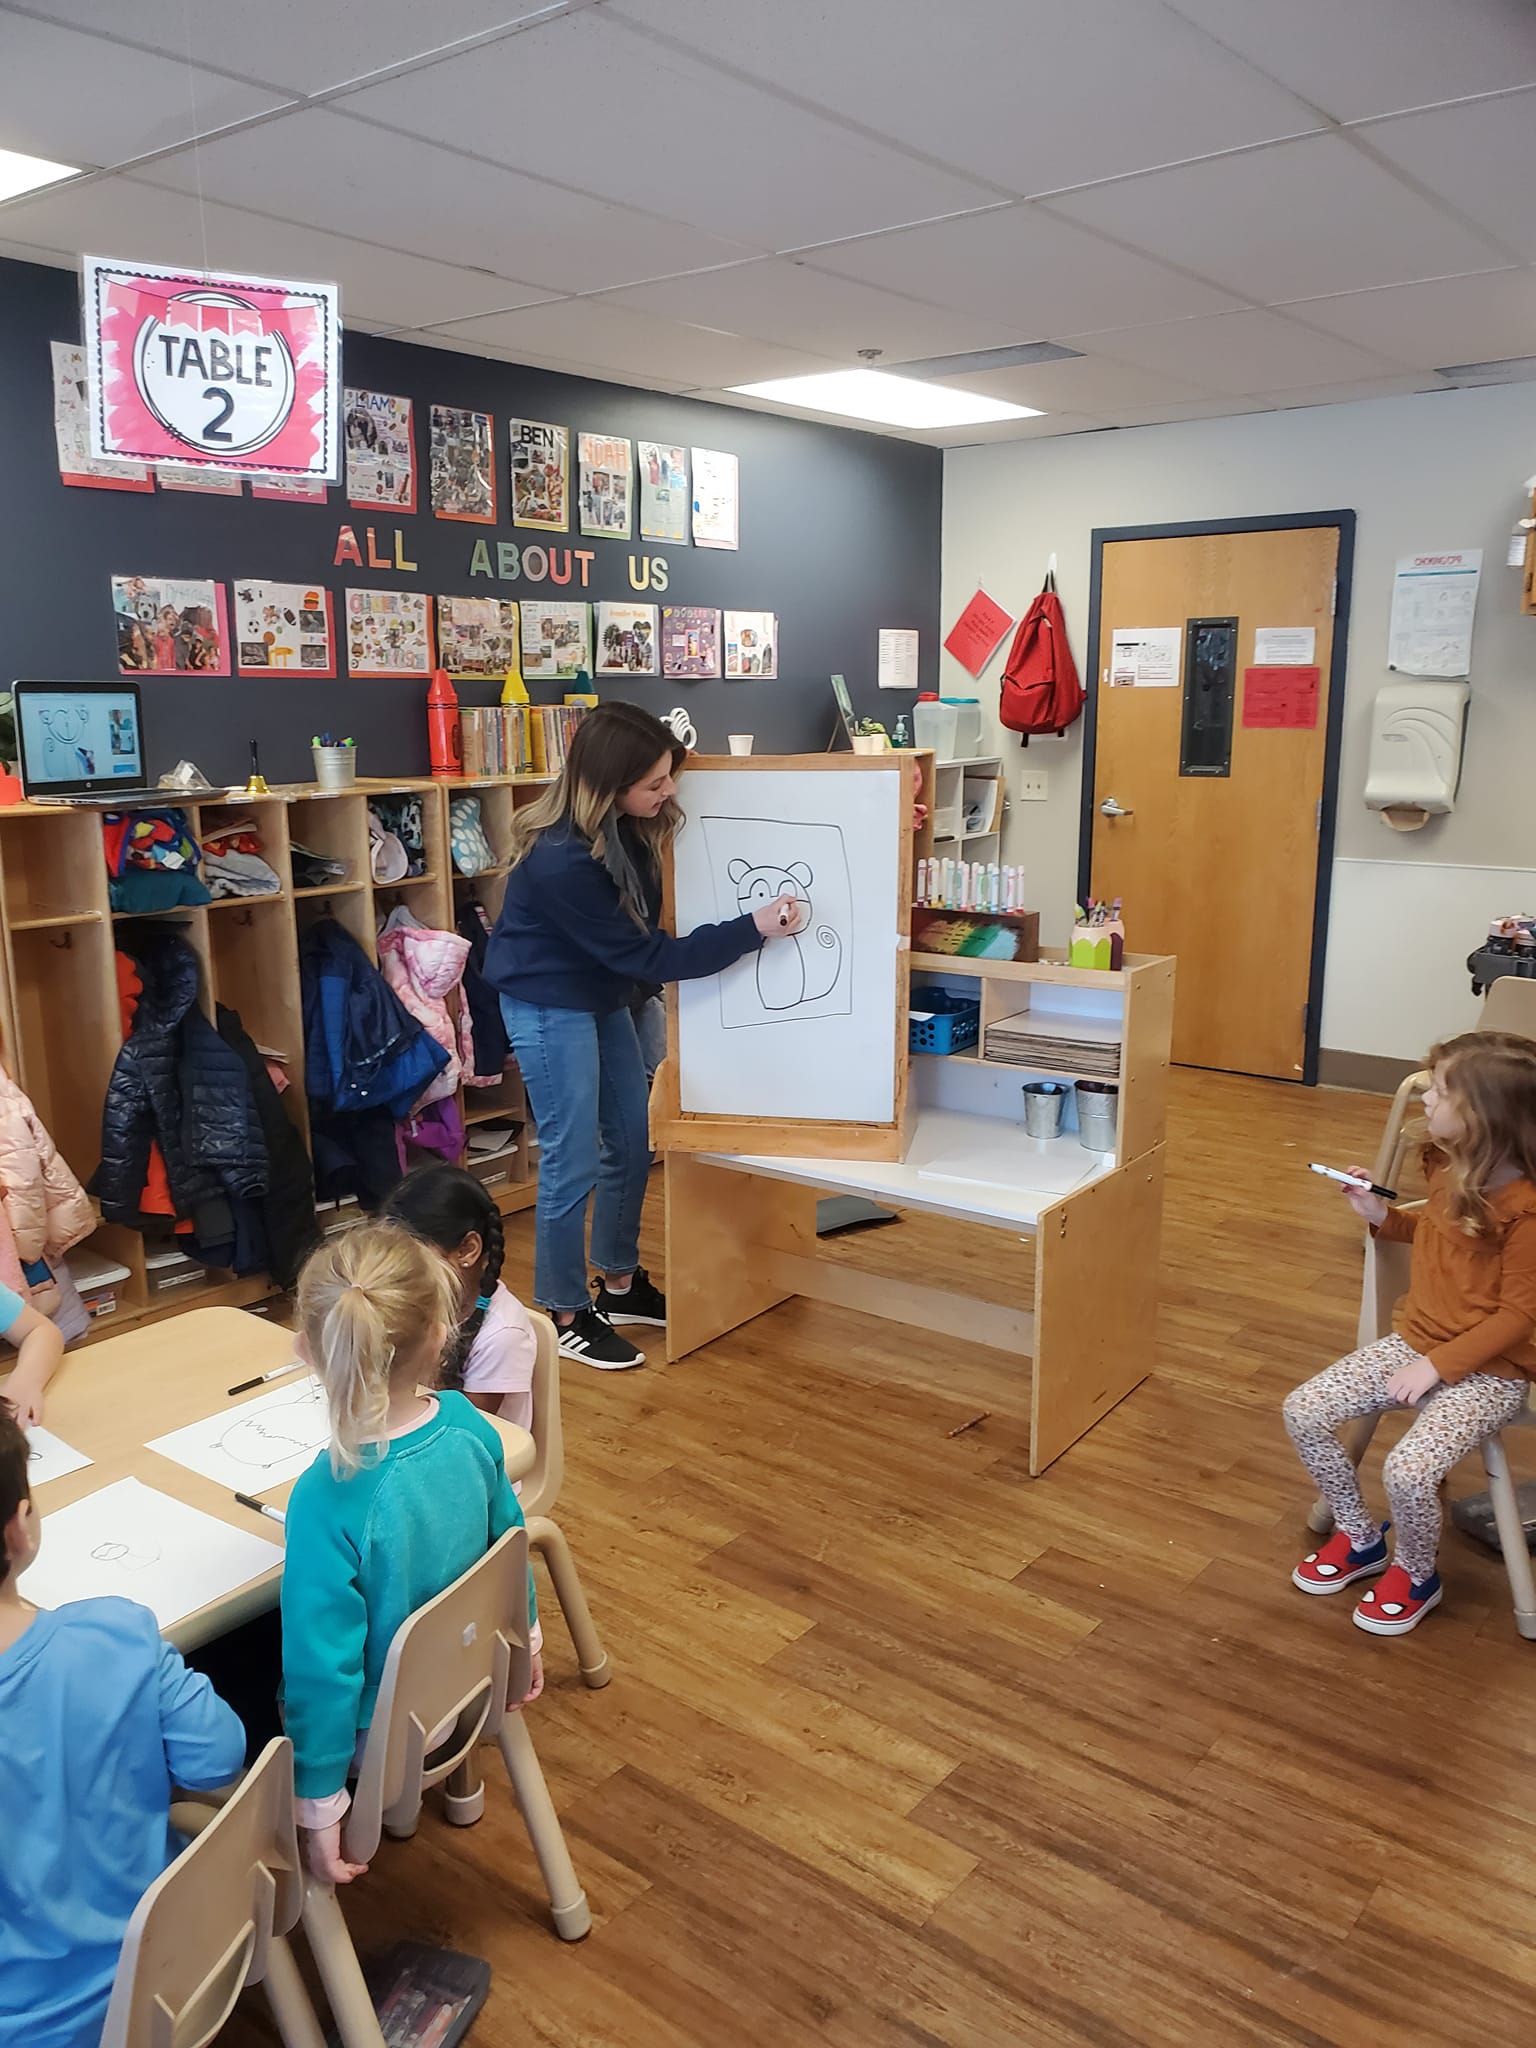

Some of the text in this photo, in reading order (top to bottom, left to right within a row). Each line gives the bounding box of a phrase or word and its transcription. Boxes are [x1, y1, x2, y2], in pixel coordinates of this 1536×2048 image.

[159, 335, 272, 387] TABLE
[202, 387, 234, 443] 2
[520, 425, 554, 448] BEN
[583, 438, 628, 471] NOAH
[333, 525, 670, 592] ALL ABOUT US
